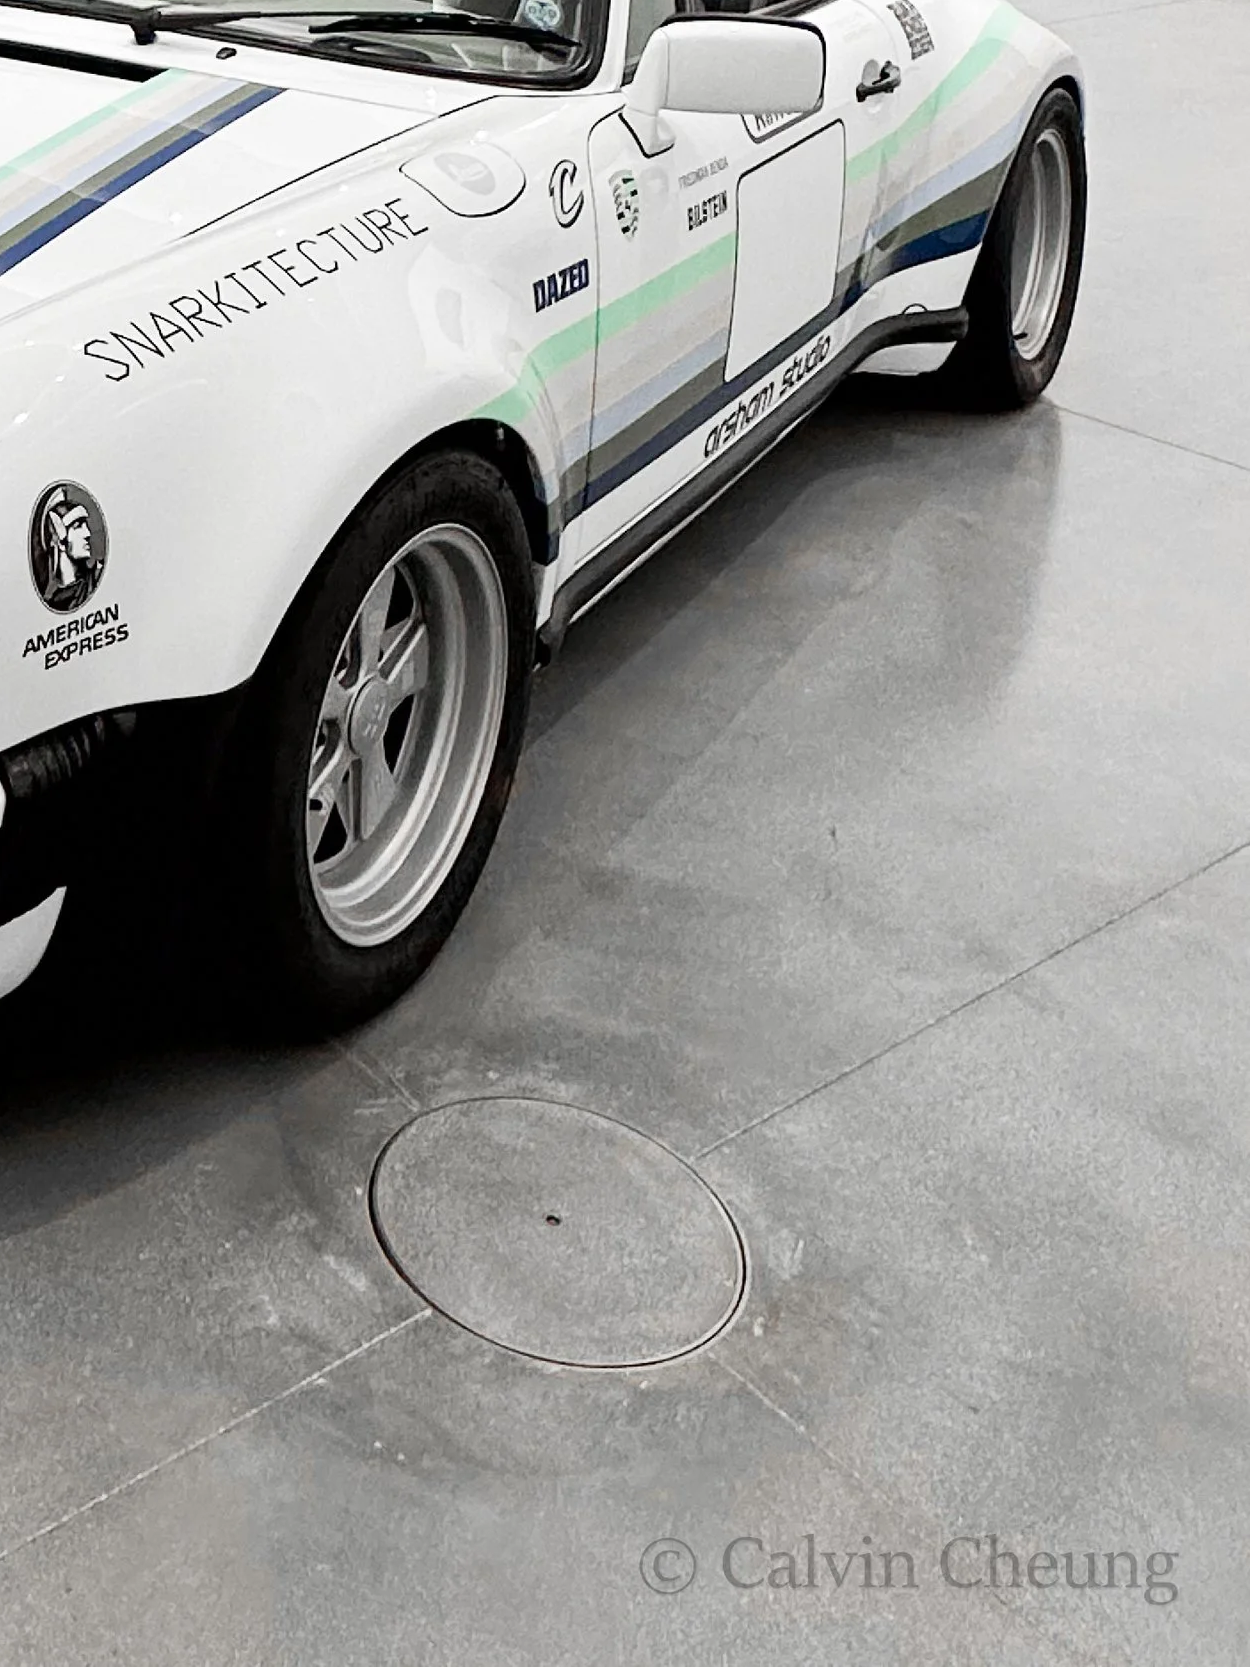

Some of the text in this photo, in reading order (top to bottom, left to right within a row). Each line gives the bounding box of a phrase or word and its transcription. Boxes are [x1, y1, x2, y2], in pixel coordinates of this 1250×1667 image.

[84, 198, 429, 381] SNARKITECTURE
[532, 258, 590, 314] DAZED
[704, 335, 831, 458] arsham studio
[22, 603, 120, 658] AMERICAN
[43, 624, 130, 670] EXPRESS
